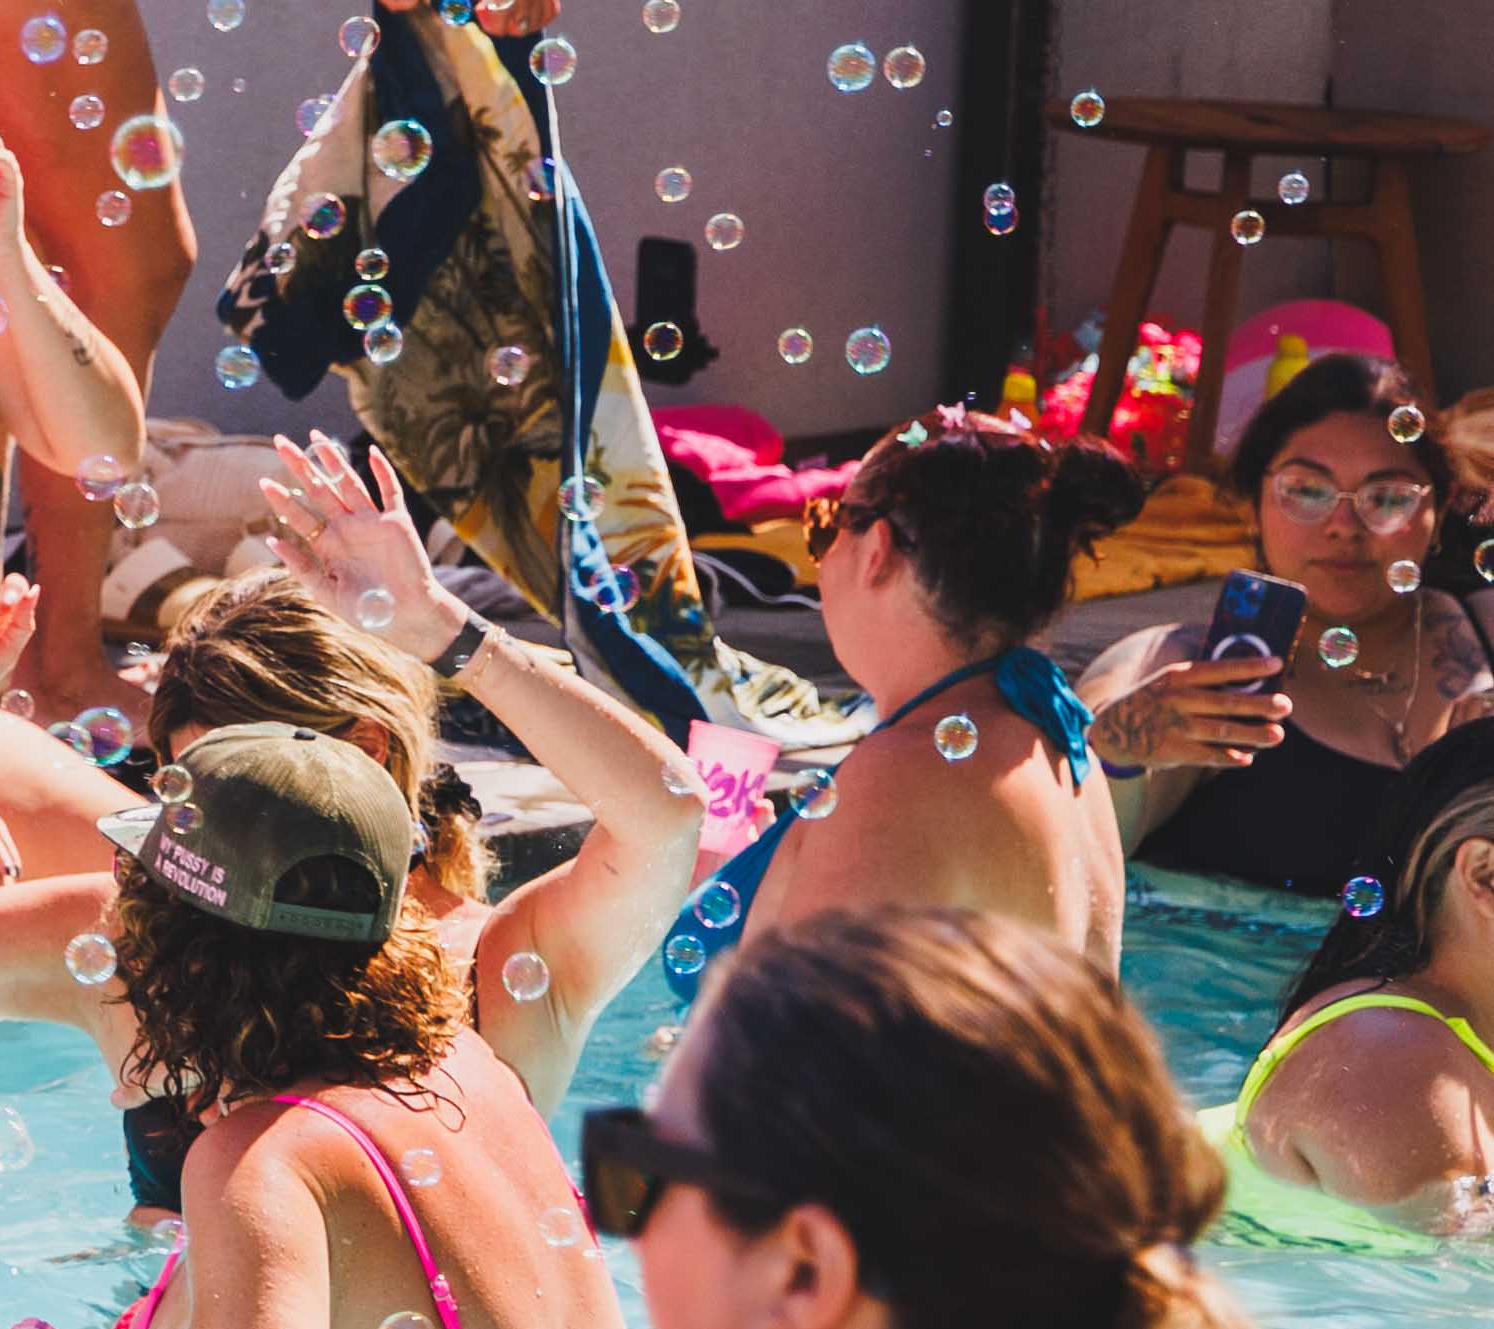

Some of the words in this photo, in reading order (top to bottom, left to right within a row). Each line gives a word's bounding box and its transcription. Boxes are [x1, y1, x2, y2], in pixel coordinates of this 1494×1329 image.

[154, 853, 162, 871] A
[162, 859, 227, 907] REVOLUTION
[173, 844, 210, 876] PUSSY
[211, 866, 226, 884] IS
